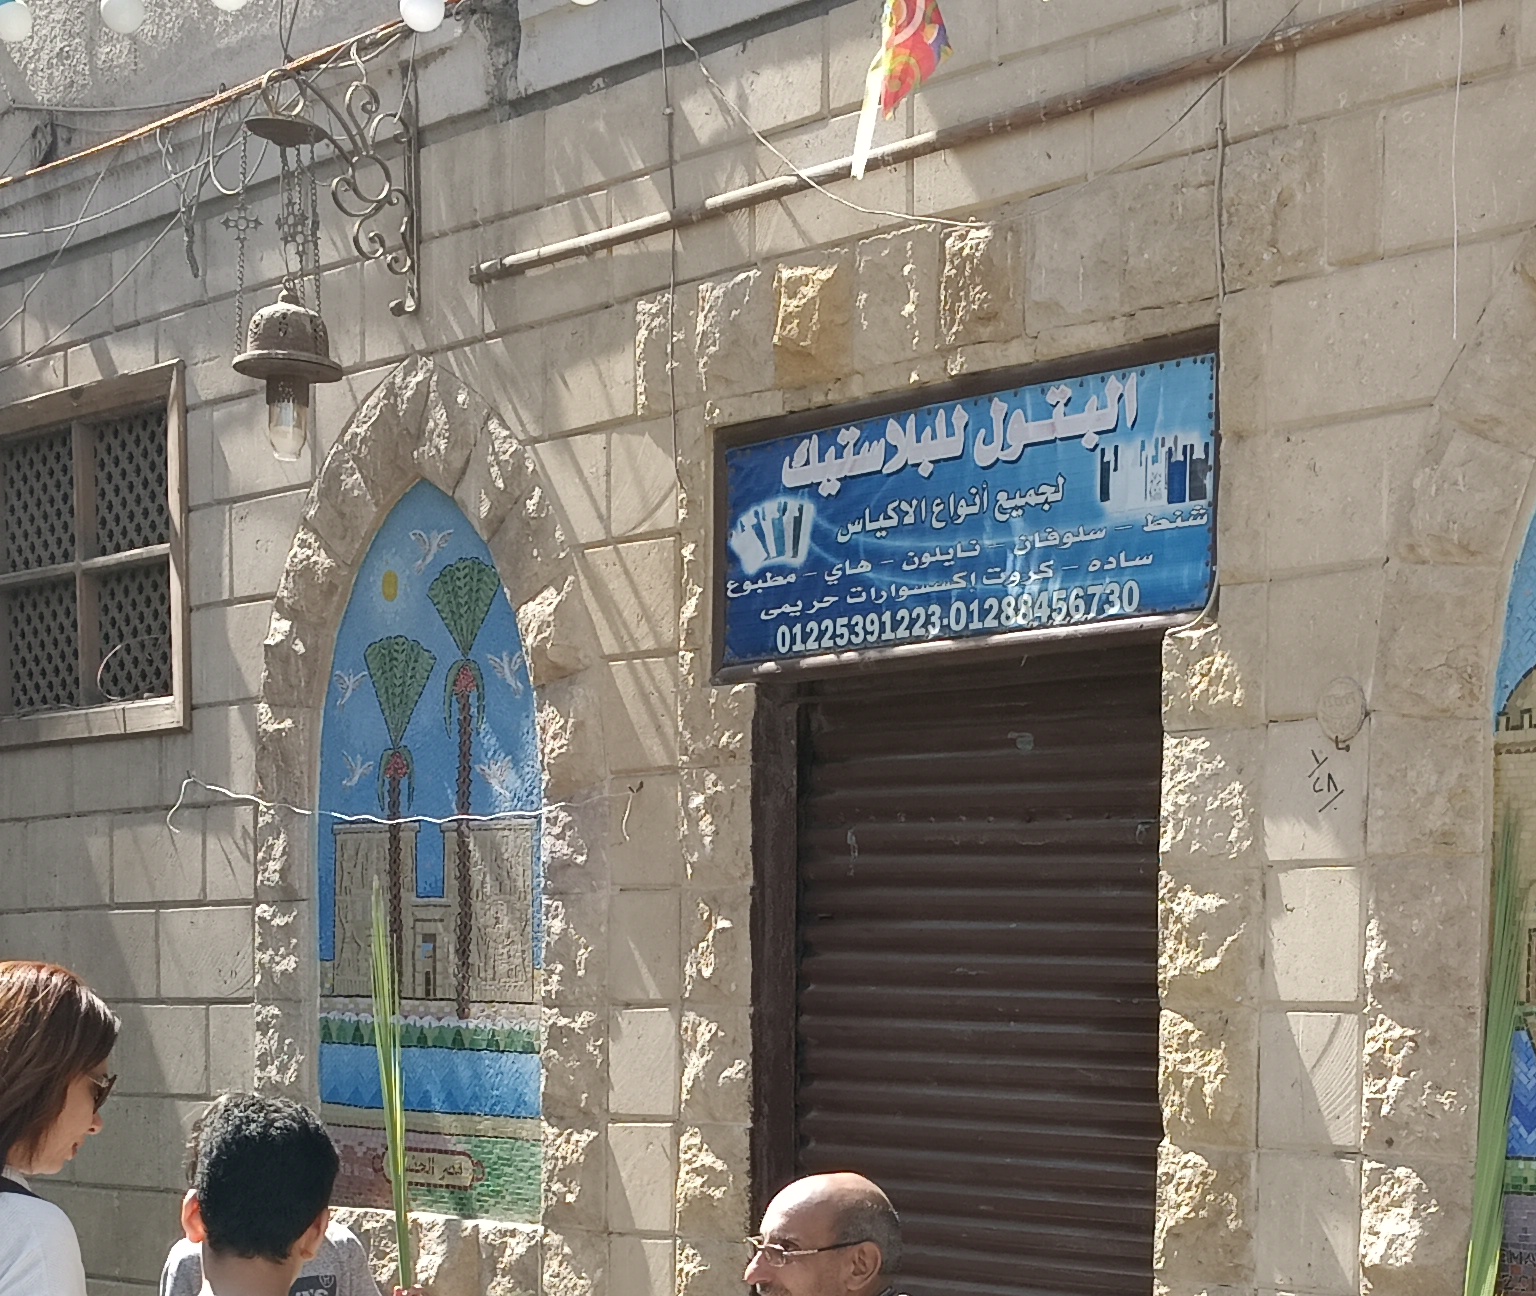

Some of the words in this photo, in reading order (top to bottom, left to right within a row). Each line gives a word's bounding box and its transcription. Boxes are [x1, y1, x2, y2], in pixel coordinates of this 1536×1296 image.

[974, 372, 1137, 467] البتول
[782, 404, 969, 497] للبلاستيك
[931, 480, 989, 529] أنواع
[994, 472, 1066, 522] لجميع
[1142, 504, 1209, 532] شنط
[836, 498, 926, 543] الاكياس
[982, 560, 1054, 586] كروت
[1087, 550, 1154, 573] ساده
[726, 571, 797, 598] مطبوع
